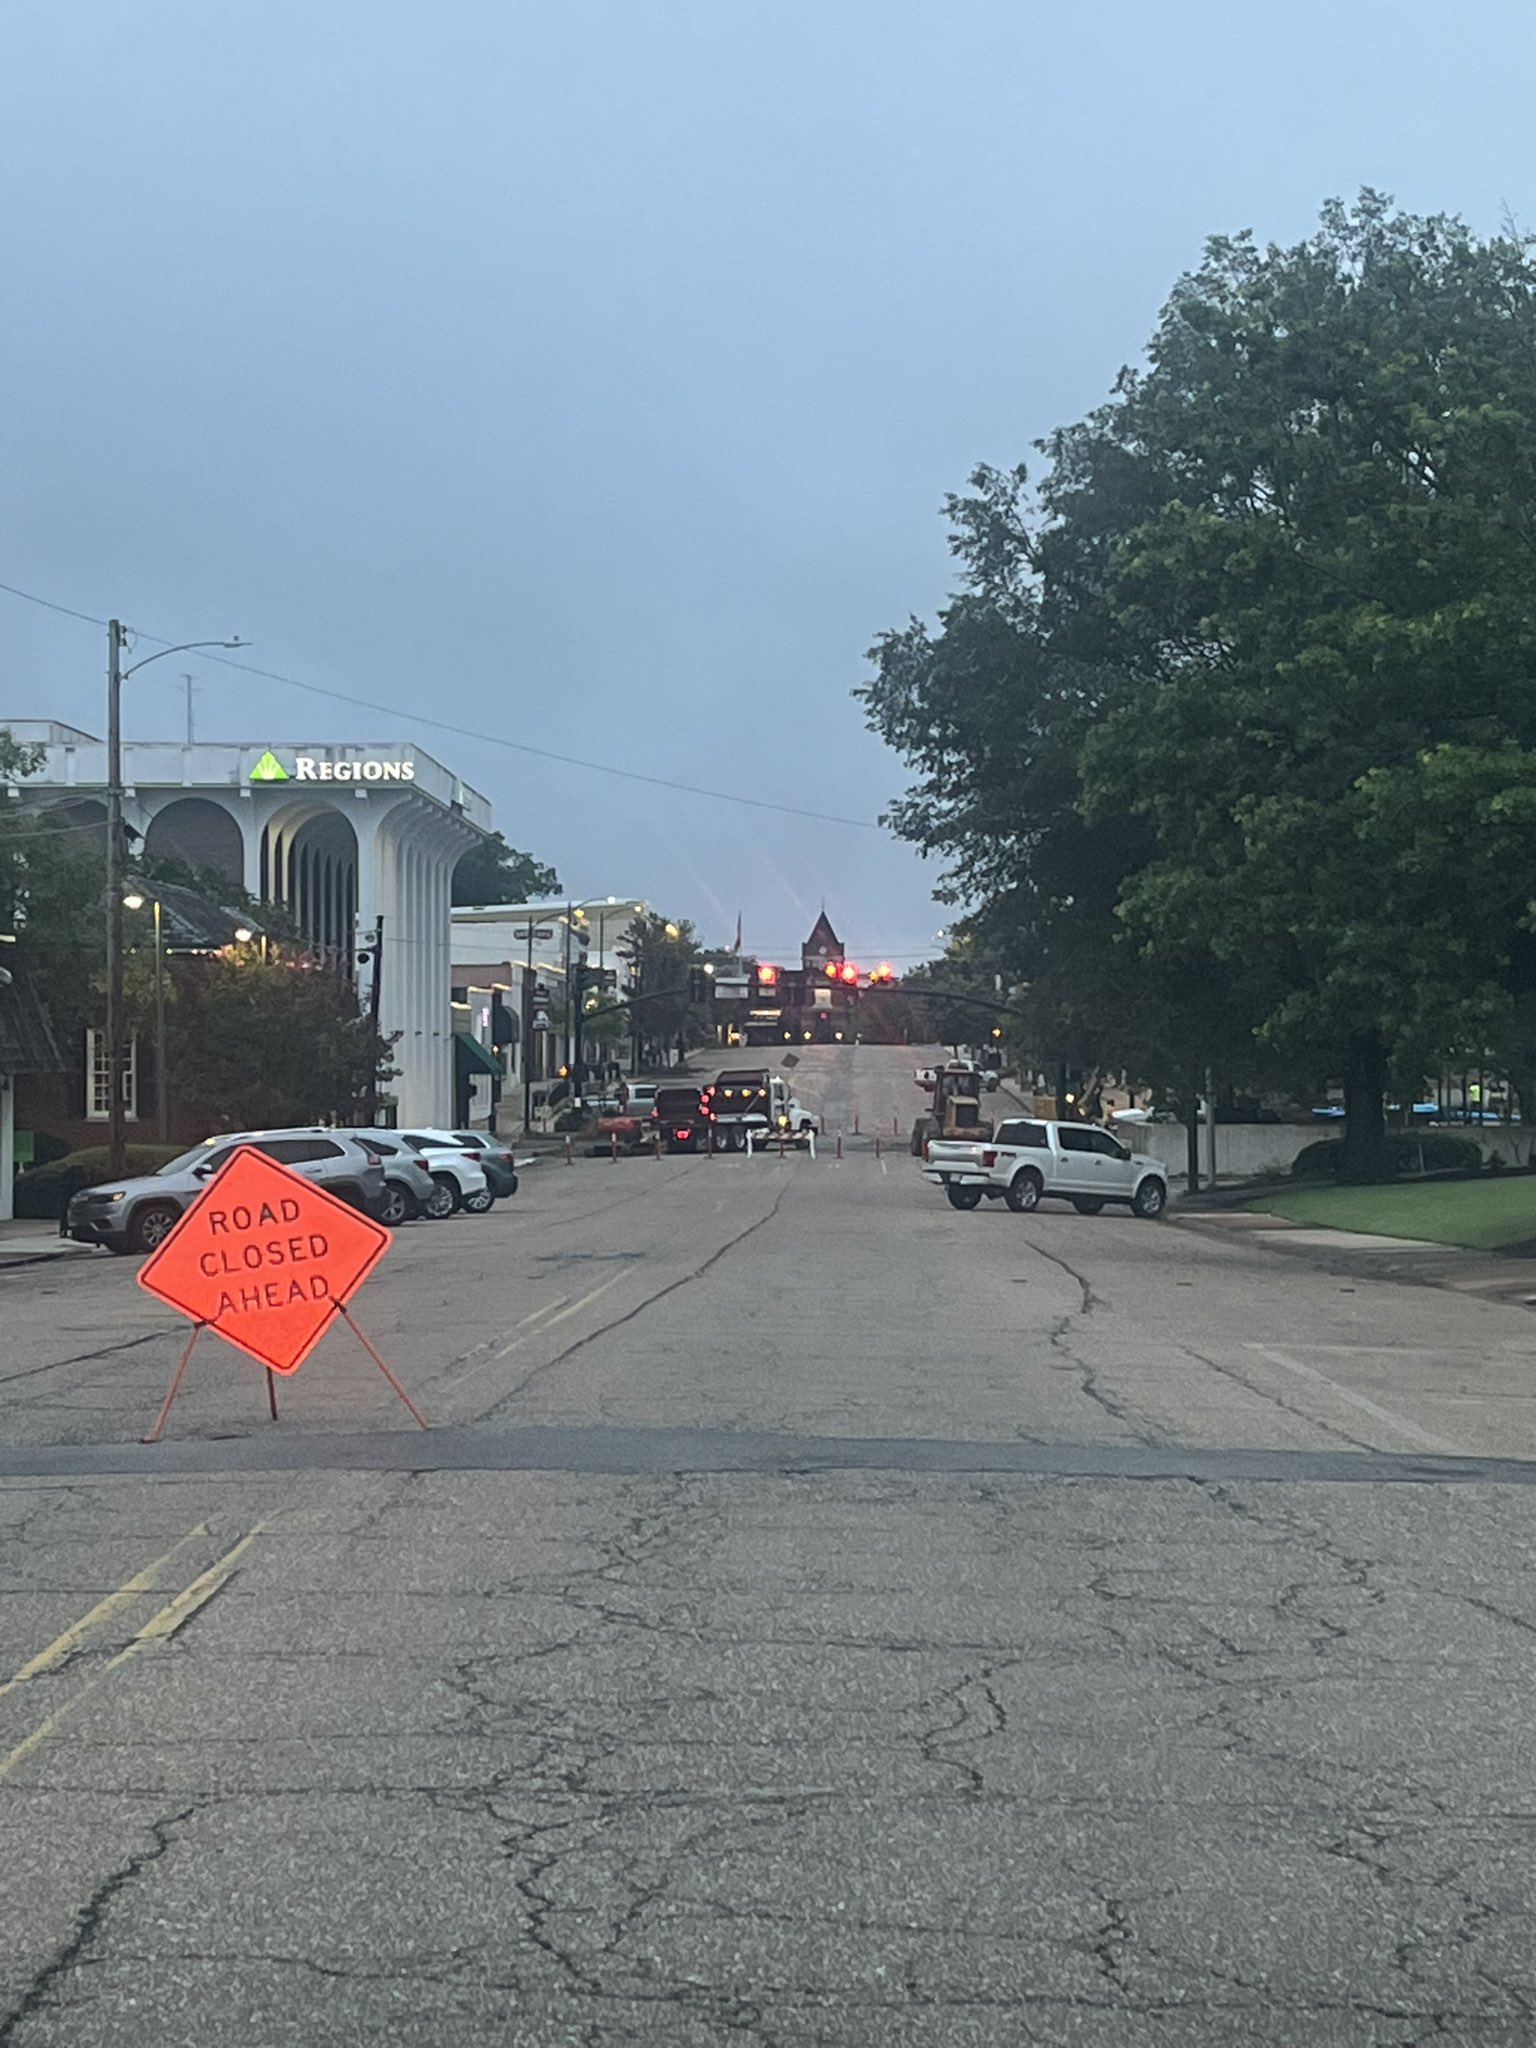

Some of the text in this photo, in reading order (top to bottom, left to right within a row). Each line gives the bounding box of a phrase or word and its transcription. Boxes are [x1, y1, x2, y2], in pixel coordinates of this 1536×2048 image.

[295, 758, 415, 781] REGIONS
[209, 1199, 300, 1235] ROAD
[200, 1234, 329, 1277] CLOSED
[218, 1275, 329, 1315] AHEAD
